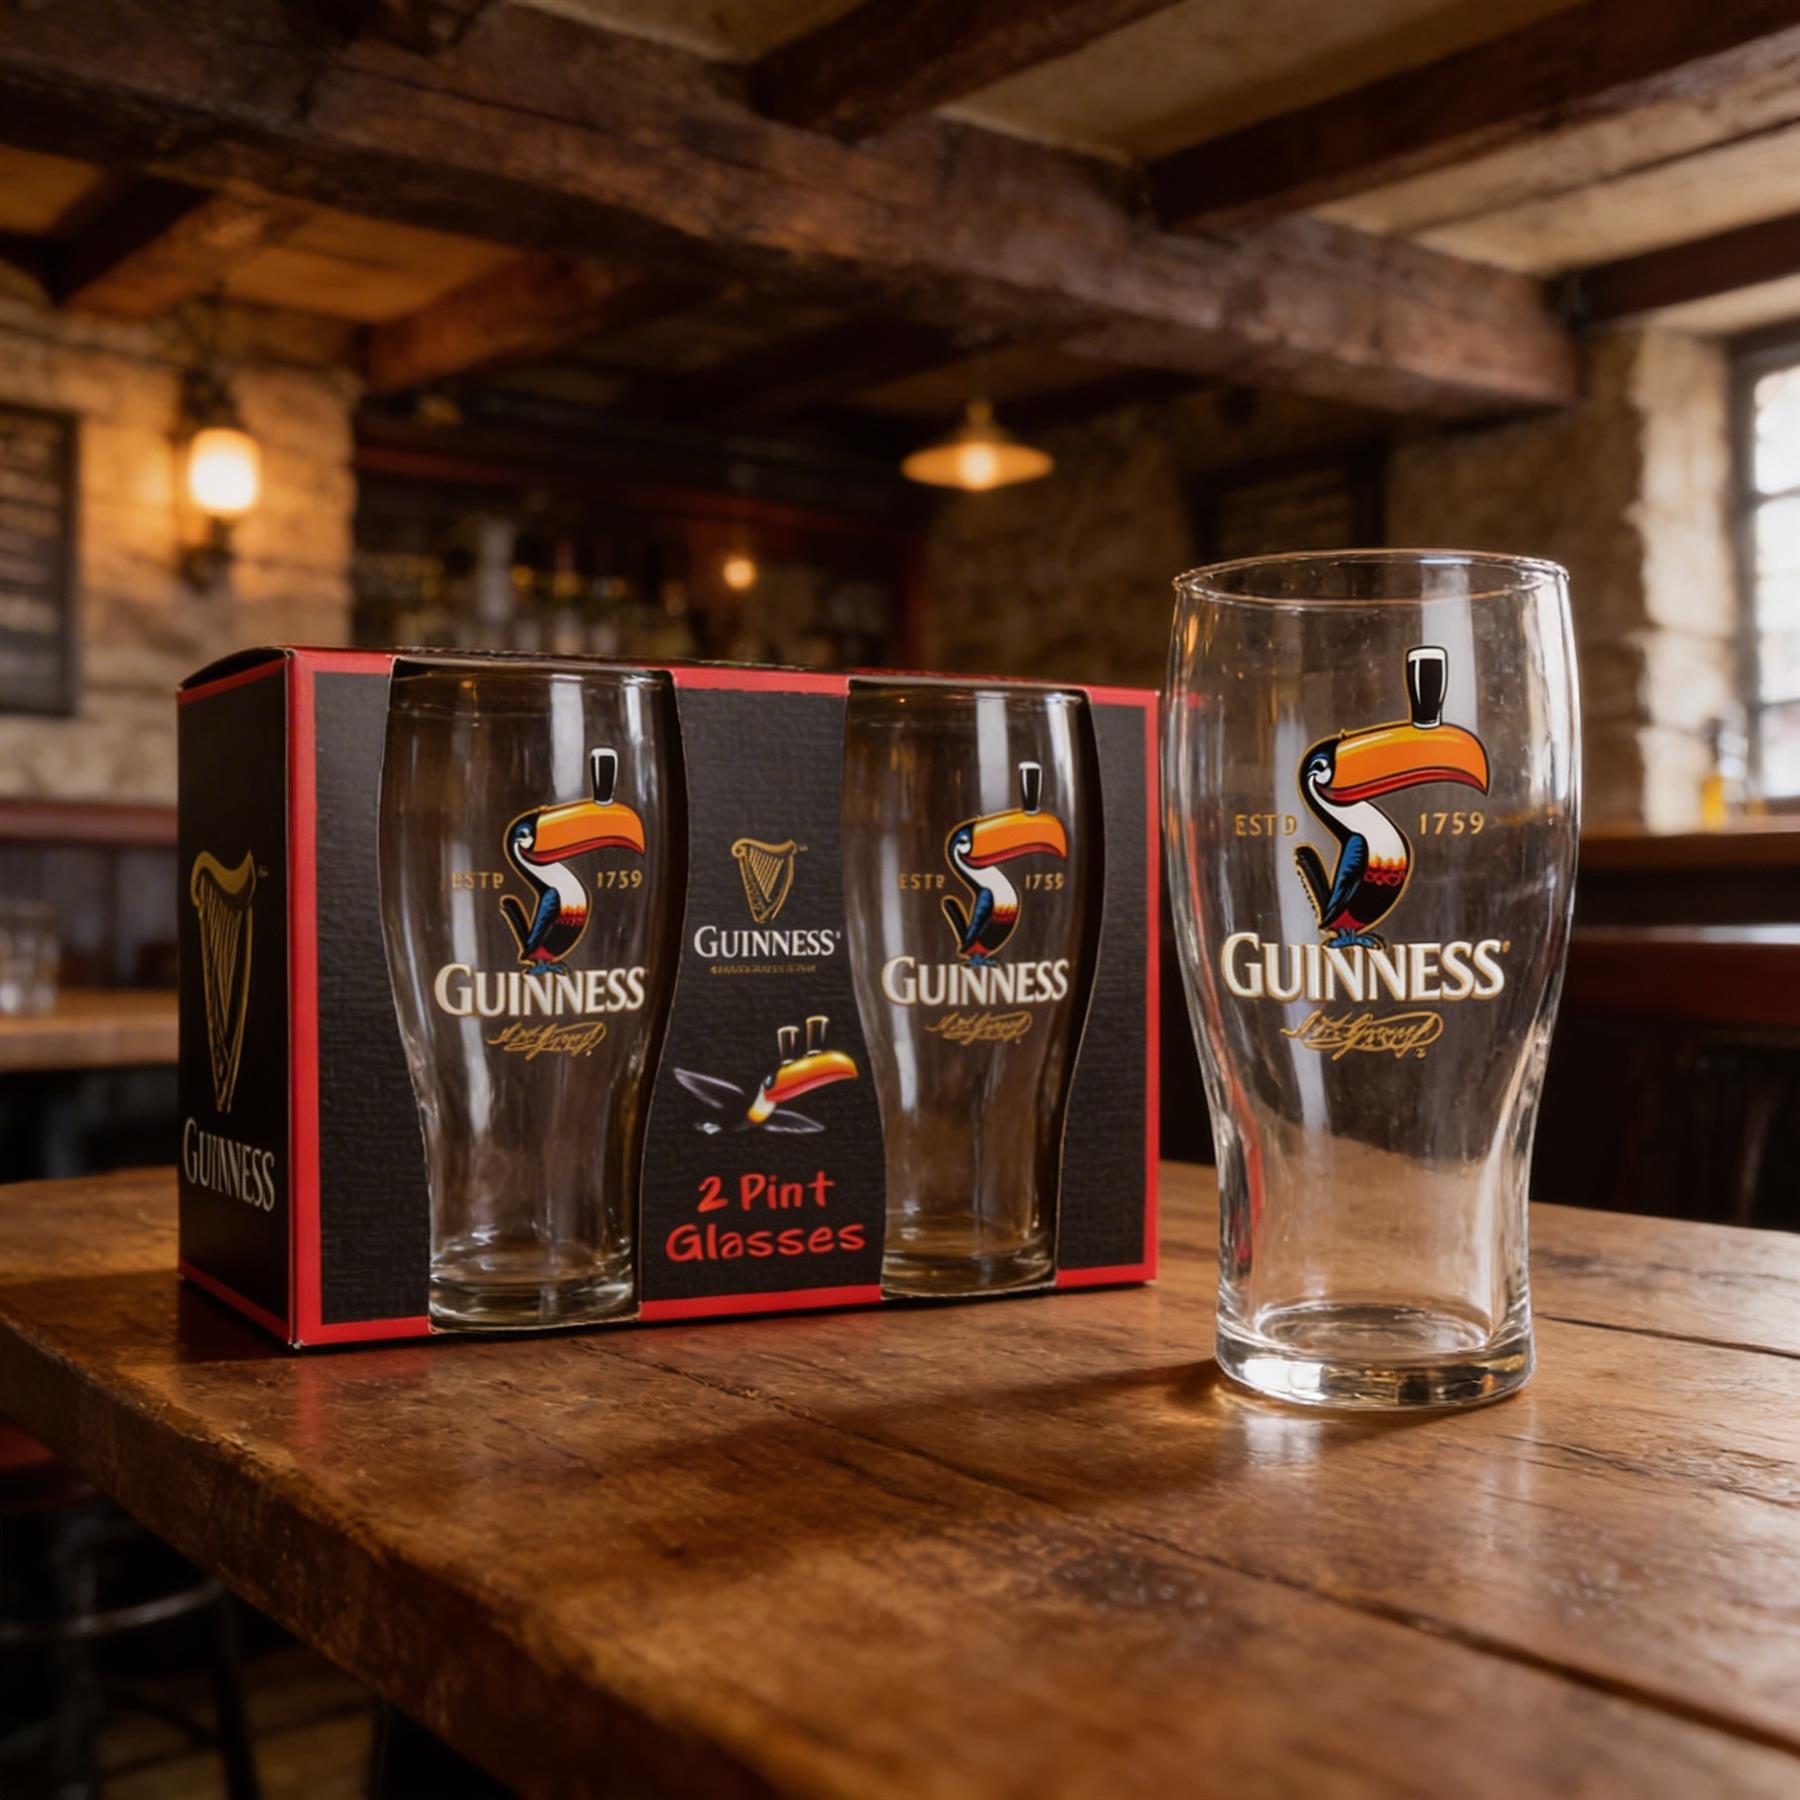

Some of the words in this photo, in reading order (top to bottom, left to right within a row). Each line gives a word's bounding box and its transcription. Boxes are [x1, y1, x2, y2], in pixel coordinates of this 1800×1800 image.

[1234, 813, 1297, 837] ESTD
[1419, 812, 1486, 835] 1759
[596, 869, 643, 890] 1759
[694, 925, 837, 958] GUINNESS
[881, 956, 1069, 1006] GUINNESS
[1220, 932, 1507, 1002] GUINNESS
[434, 962, 647, 1018] GUINNESS
[184, 1117, 276, 1212] GUINNESS
[697, 1175, 729, 1213] 2
[740, 1171, 836, 1211] Pint
[665, 1223, 866, 1262] Glasses
